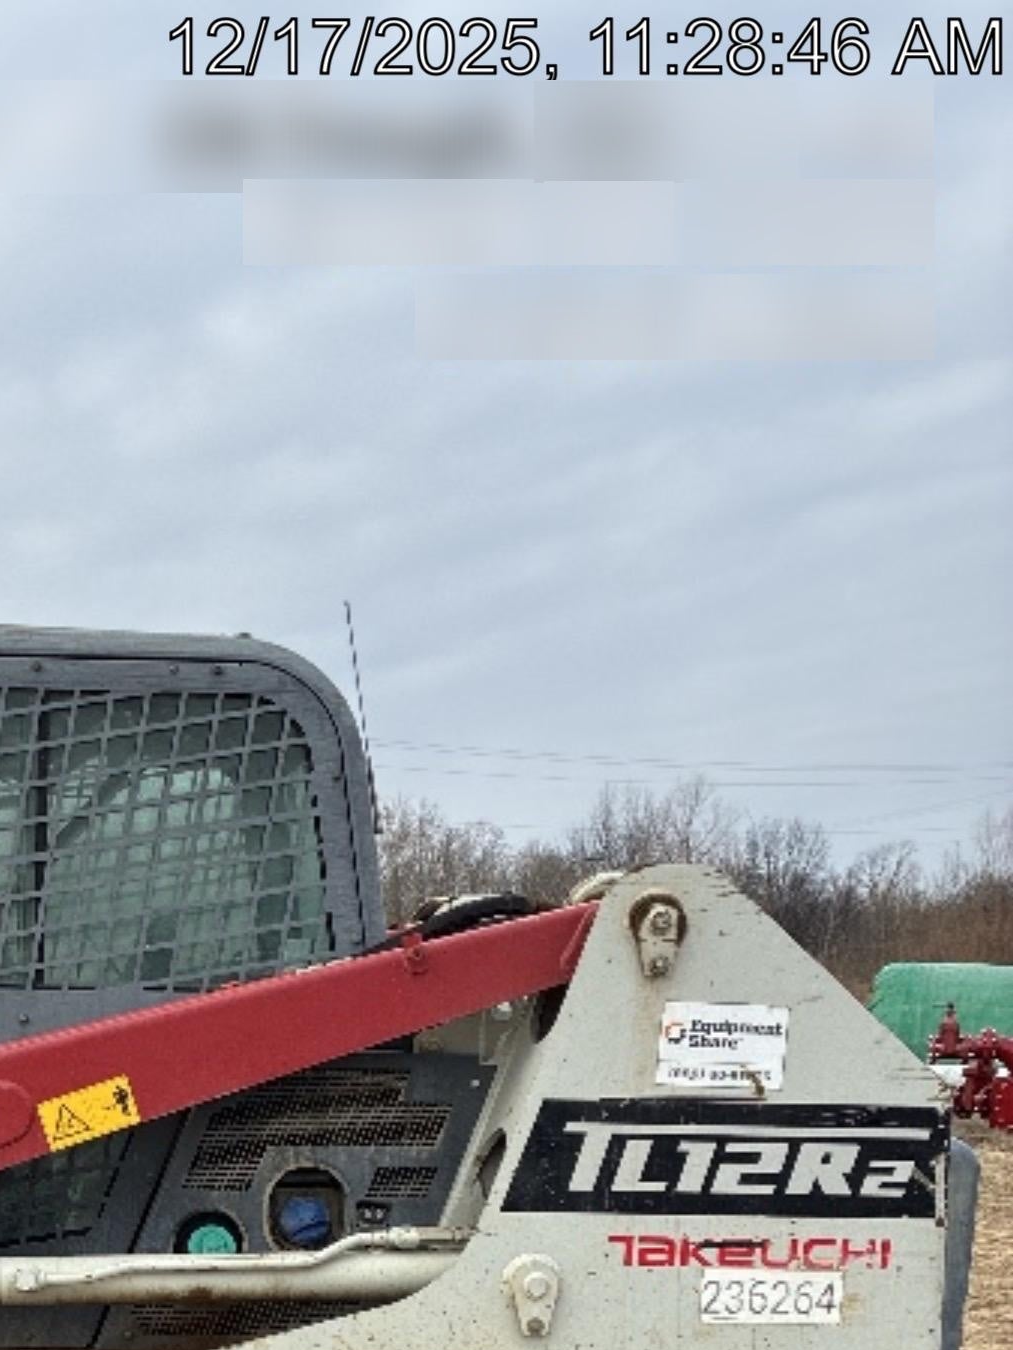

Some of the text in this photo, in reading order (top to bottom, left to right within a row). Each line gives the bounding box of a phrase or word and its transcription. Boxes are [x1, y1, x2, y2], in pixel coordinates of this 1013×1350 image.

[690, 1020, 783, 1036] Equipment
[689, 1035, 739, 1050] Share
[564, 1121, 931, 1199] TL12R2
[702, 1279, 838, 1317] 236264
